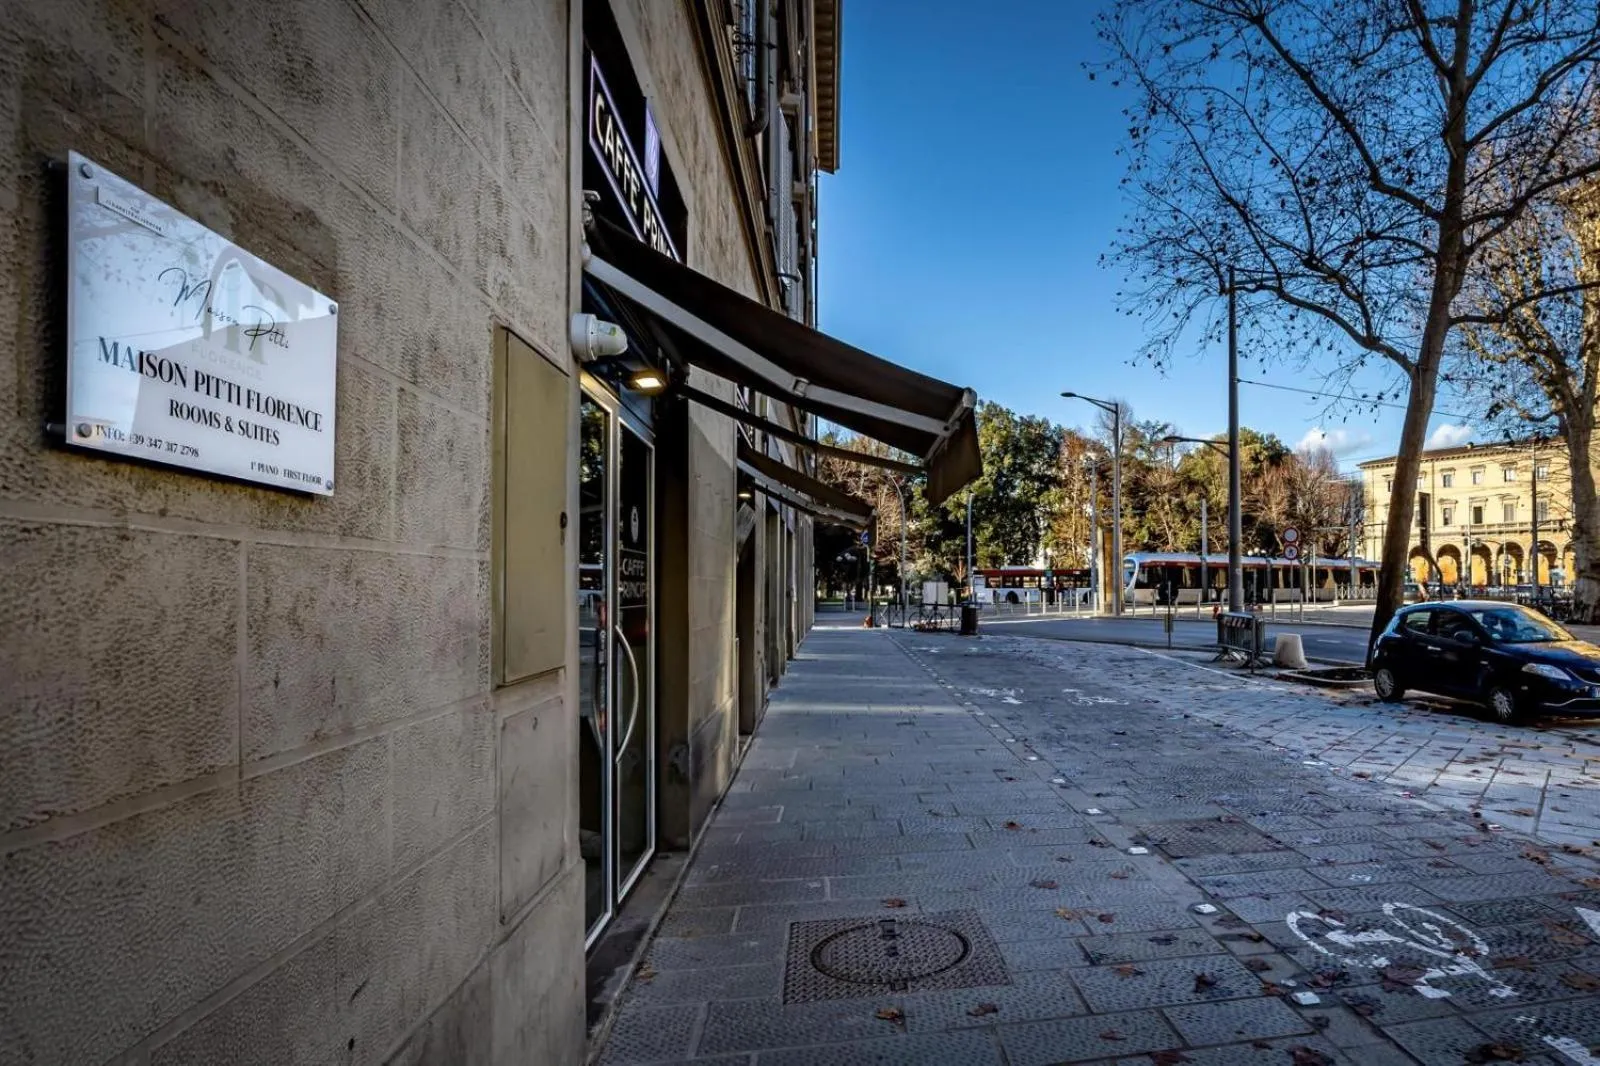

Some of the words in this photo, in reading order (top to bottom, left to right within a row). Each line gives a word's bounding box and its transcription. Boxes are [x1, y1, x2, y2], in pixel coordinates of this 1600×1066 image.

[643, 196, 673, 259] PRIN
[158, 267, 240, 326] Maison
[242, 305, 289, 351] Pitti
[98, 336, 187, 389] MAISON
[194, 369, 241, 406] PITTI
[246, 388, 322, 433] FLORENCE
[96, 424, 125, 442] INFO:
[147, 438, 162, 449] 347
[165, 442, 178, 454] 317
[180, 445, 200, 458] 2798
[169, 398, 221, 430] ROOMS
[224, 416, 234, 433] &
[238, 419, 280, 446] SUITES
[257, 462, 279, 476] PIANO
[283, 468, 301, 481] FIRST
[302, 473, 322, 485] FLOOR
